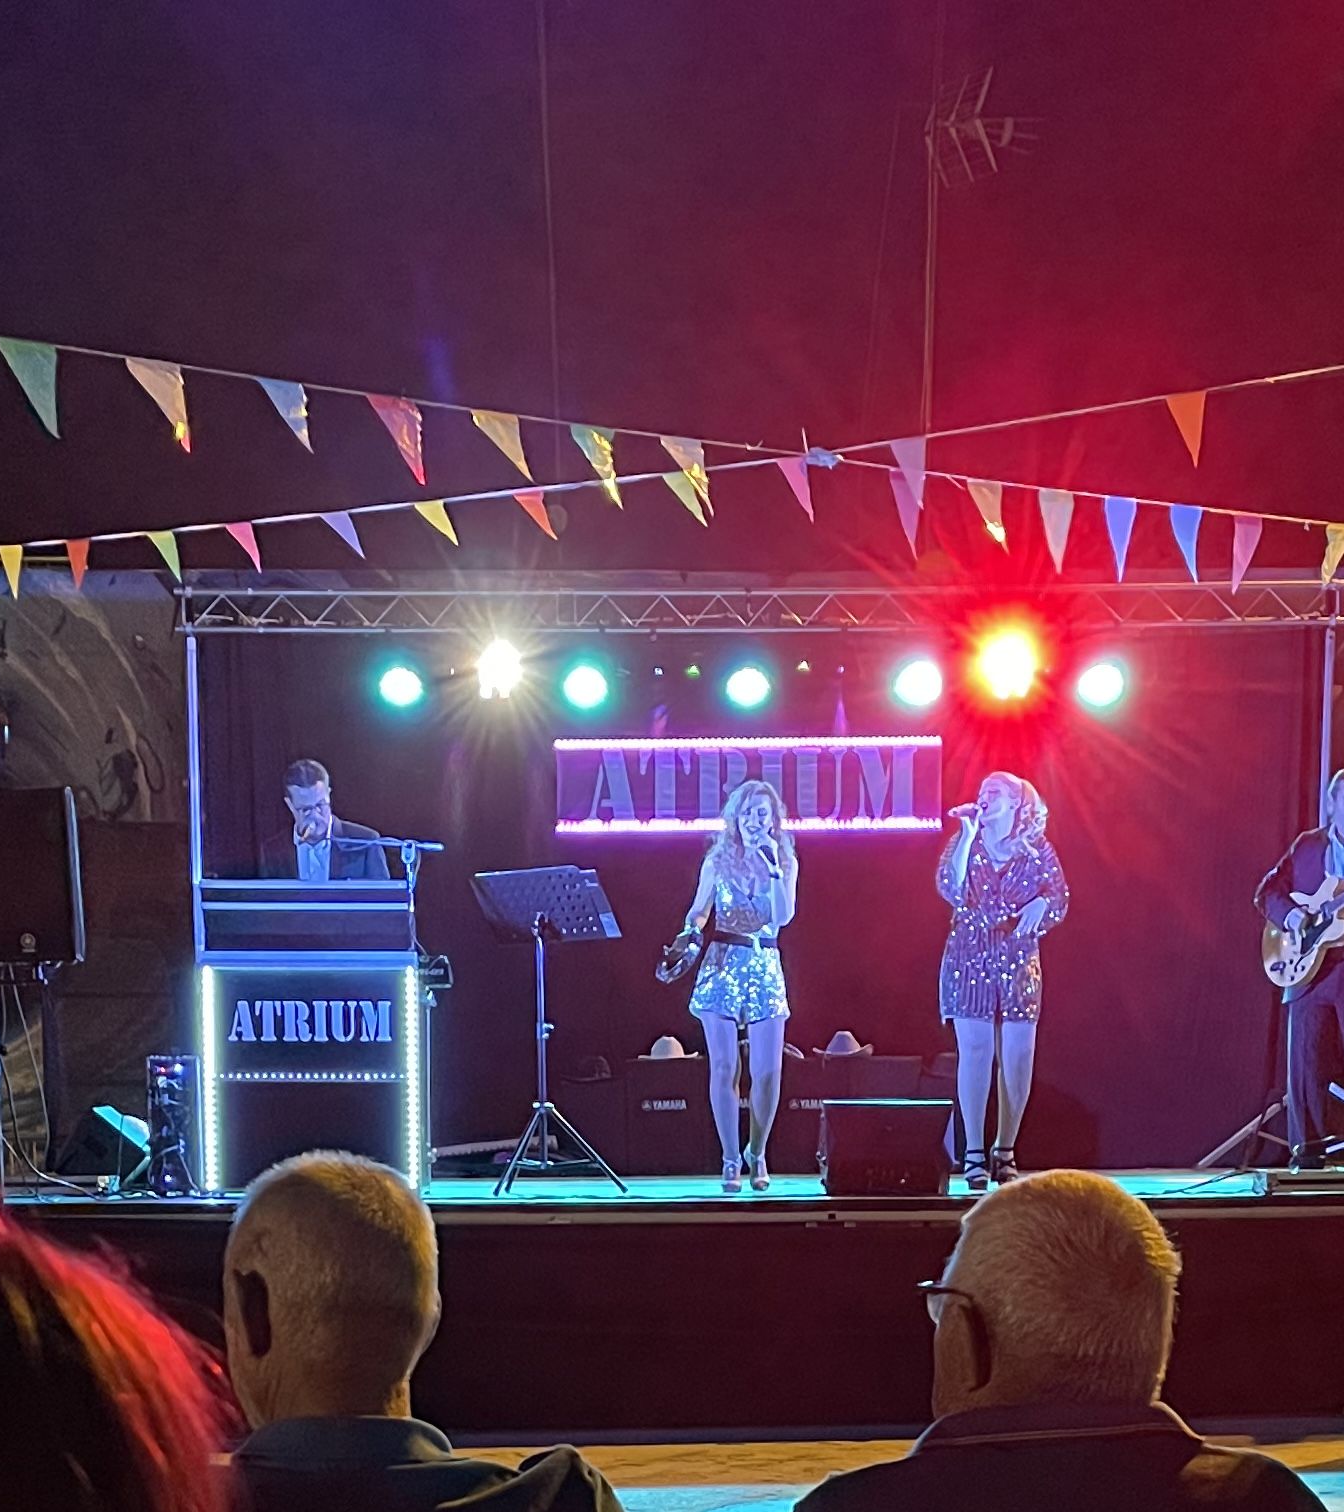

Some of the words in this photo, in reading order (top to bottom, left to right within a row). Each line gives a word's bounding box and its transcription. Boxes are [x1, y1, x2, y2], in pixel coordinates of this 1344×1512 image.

[586, 746, 918, 821] ATRIUM
[228, 1000, 392, 1042] ATRIUM
[652, 1099, 687, 1110] YAMAHA
[800, 1099, 823, 1109] YAMA
